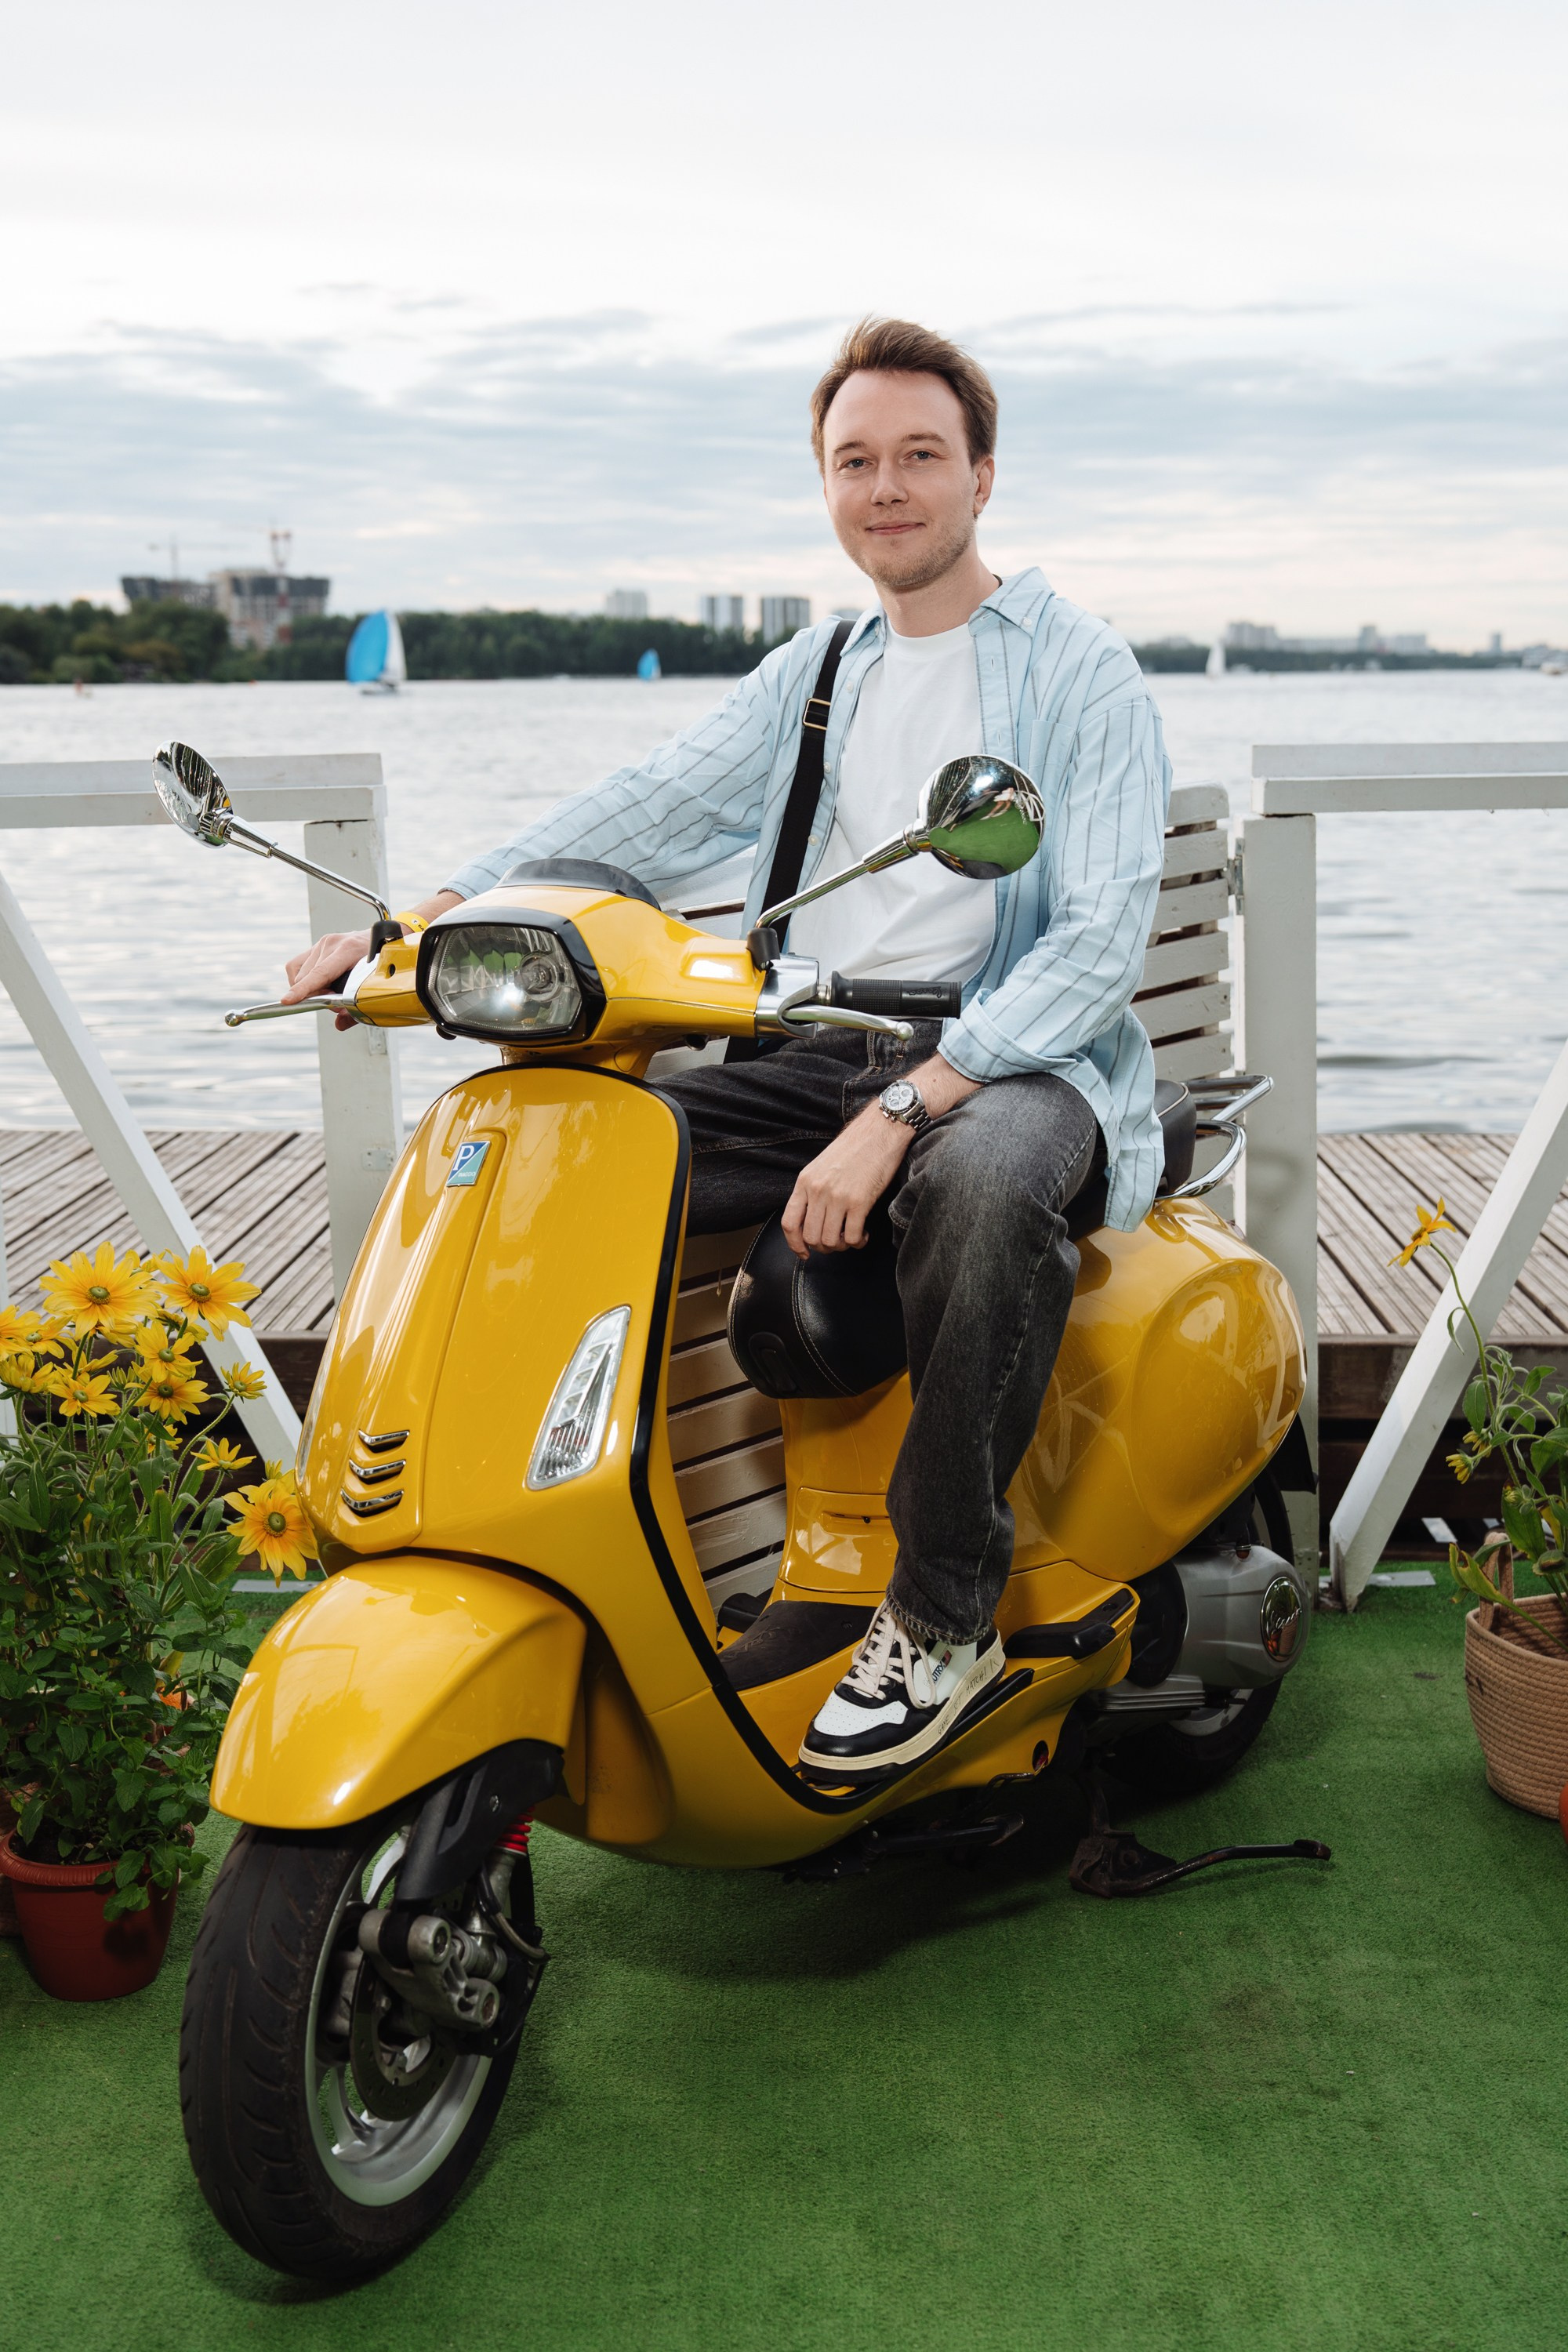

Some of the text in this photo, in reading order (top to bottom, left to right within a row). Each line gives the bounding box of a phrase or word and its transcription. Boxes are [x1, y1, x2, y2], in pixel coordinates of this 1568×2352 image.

[452, 1145, 475, 1171] P
[931, 1661, 945, 1684] UTRY
[965, 1666, 988, 1697] MATCH!
